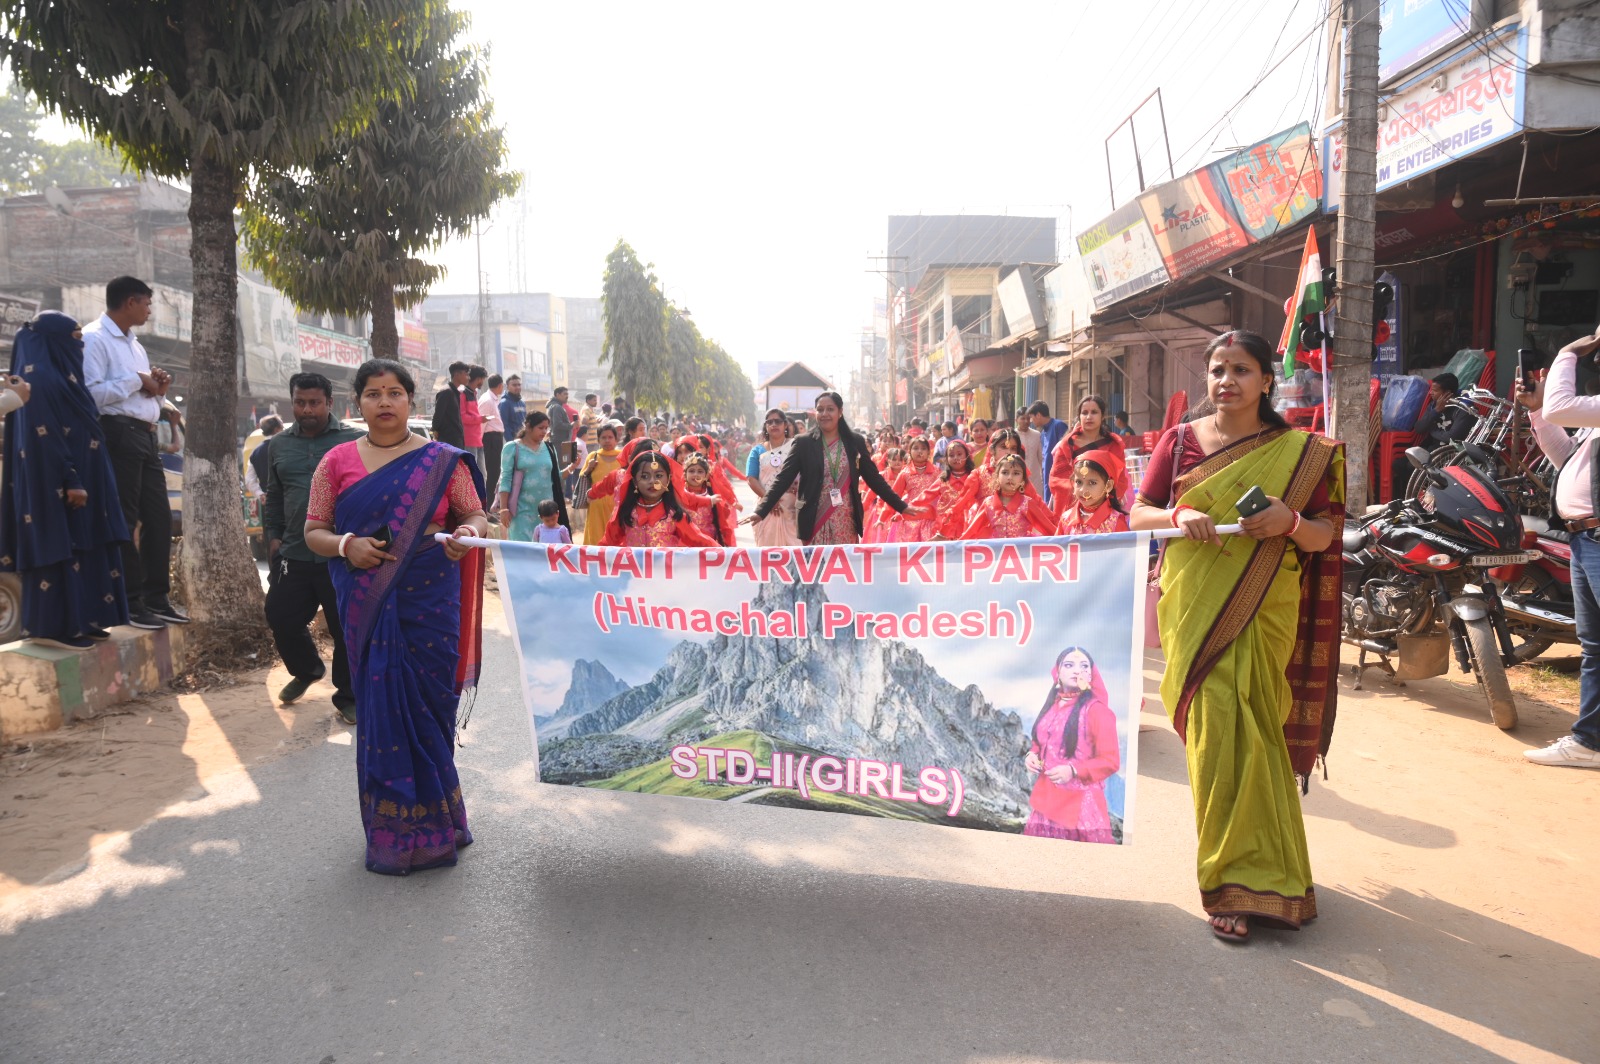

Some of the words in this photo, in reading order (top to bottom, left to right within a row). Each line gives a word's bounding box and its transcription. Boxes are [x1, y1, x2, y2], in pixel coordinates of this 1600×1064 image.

[1397, 118, 1493, 174] ENTERPRIES
[1154, 204, 1208, 235] LIRA
[1180, 213, 1210, 232] PLASTIC
[1078, 222, 1110, 254] BOROSIL
[1184, 245, 1210, 260] SUSHILA
[1210, 231, 1237, 247] TRADERS
[547, 543, 680, 580] KHAIT
[699, 546, 883, 584] PARVAT
[900, 545, 944, 583] KI
[963, 544, 1080, 582] PARI
[593, 592, 806, 639] (Himachal
[823, 601, 1034, 646] Pradesh)
[671, 745, 965, 816] STD-II(GIRLS)
